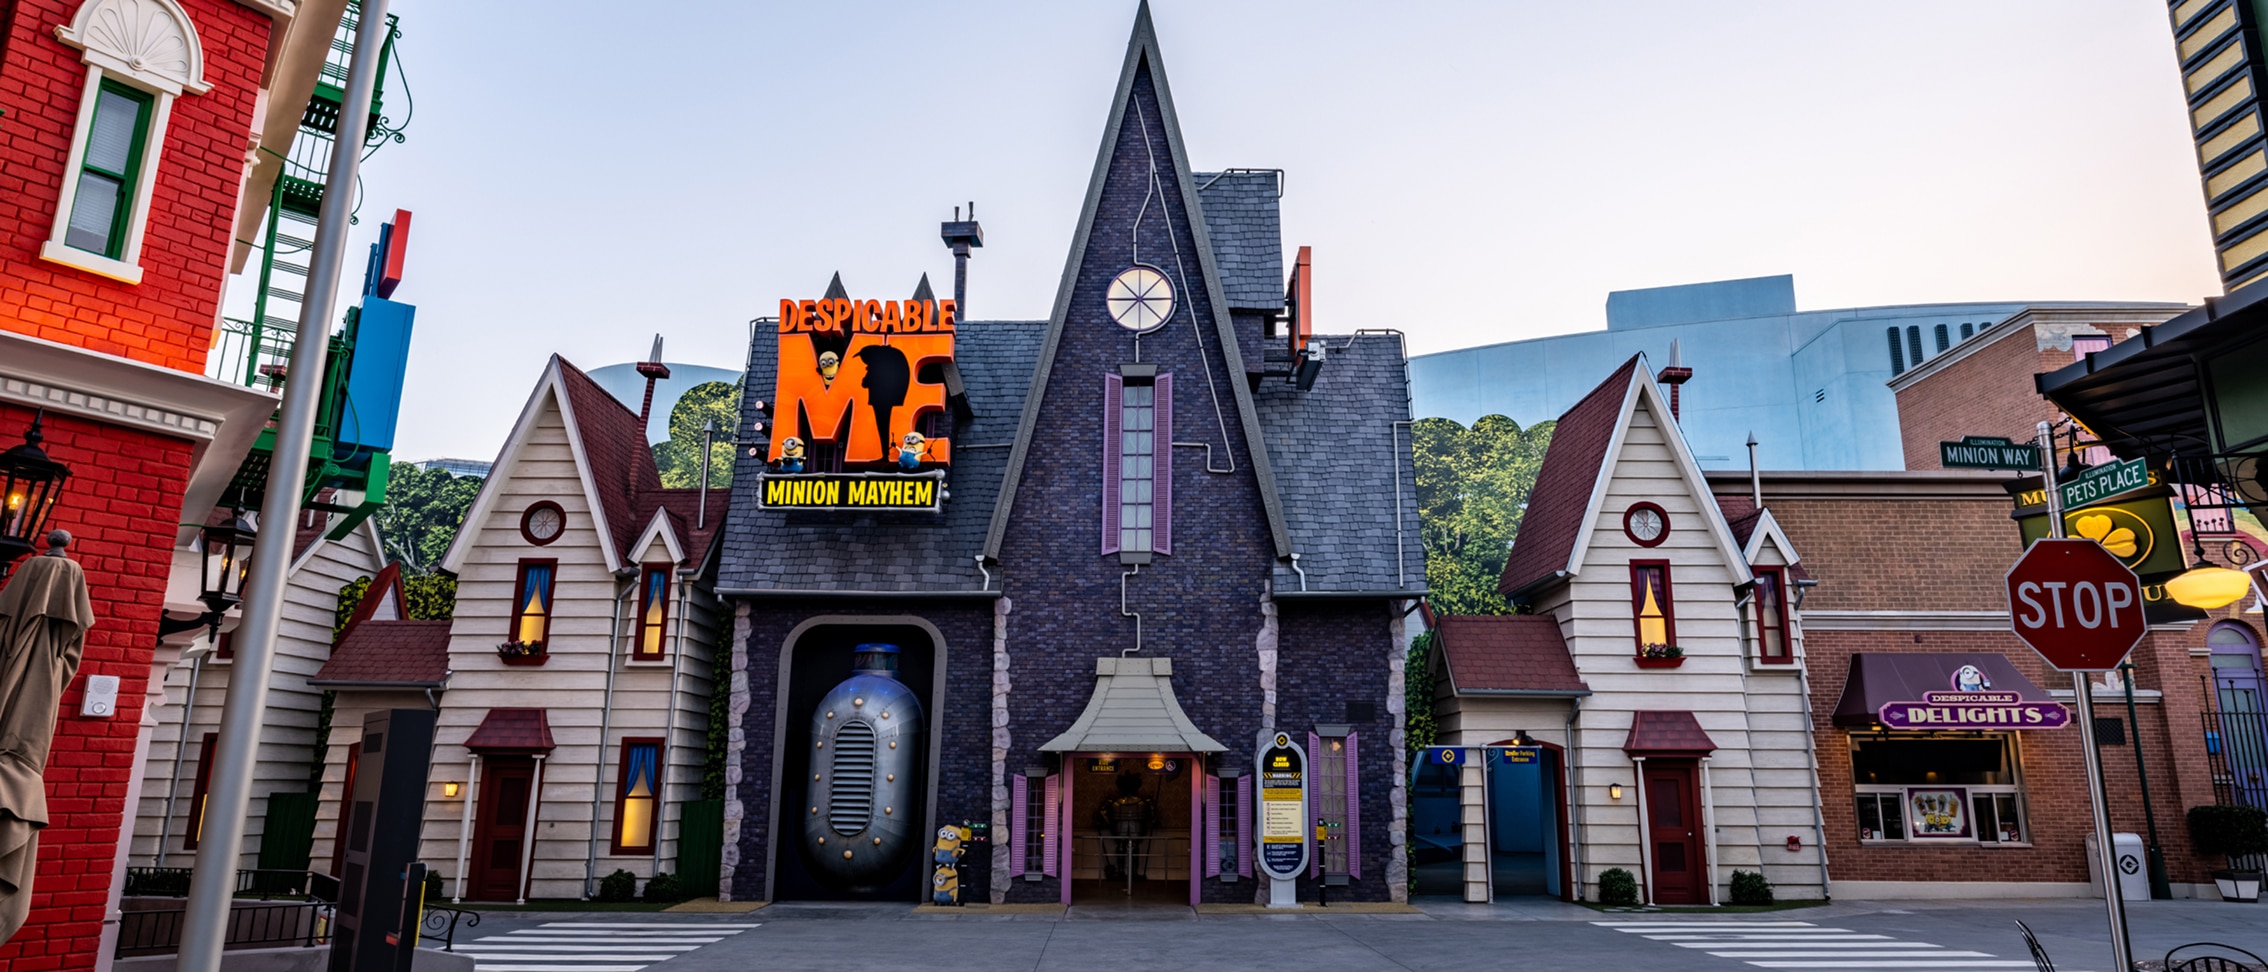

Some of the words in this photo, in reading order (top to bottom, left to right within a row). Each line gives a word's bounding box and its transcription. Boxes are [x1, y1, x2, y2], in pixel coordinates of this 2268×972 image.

[779, 298, 957, 336] DESPICABLE
[767, 333, 955, 466] ME
[1969, 438, 2006, 447] ILLUMINATION
[1946, 446, 1999, 464] MINION
[2002, 448, 2030, 466] WAY
[2085, 463, 2117, 480] ILLUMINATION
[766, 480, 841, 505] MINION
[847, 480, 933, 506] MAYHEM
[2066, 480, 2097, 505] PETS
[2099, 464, 2143, 495] PLACE
[2017, 580, 2133, 630] STOP
[1931, 694, 2013, 702] DESPICABLE
[1907, 706, 2043, 724] DELIGHTS
